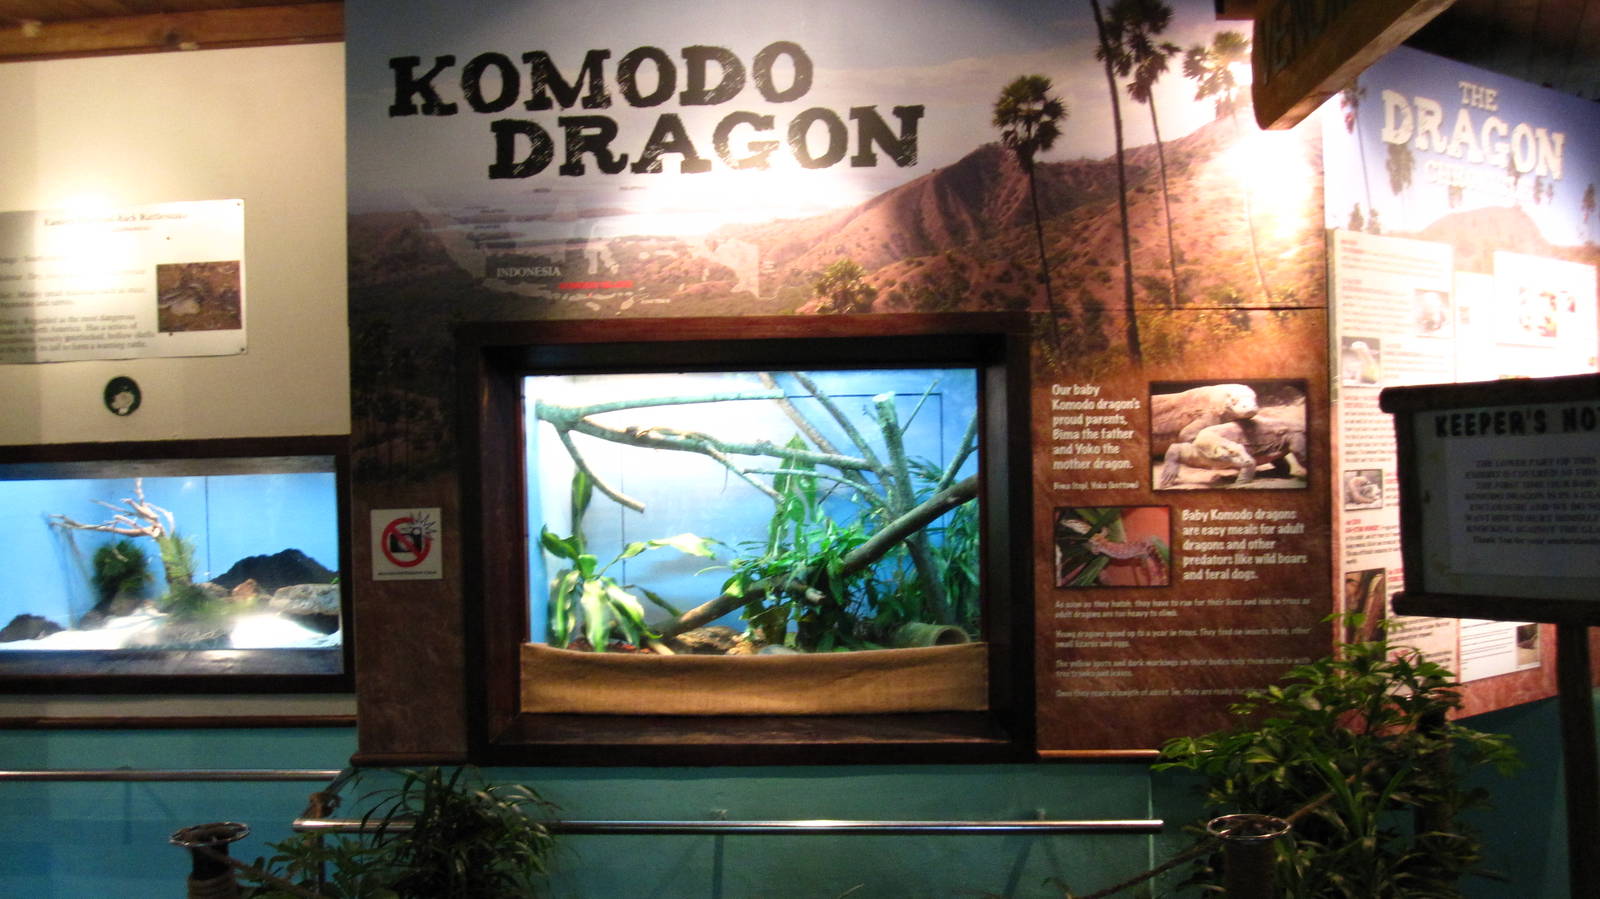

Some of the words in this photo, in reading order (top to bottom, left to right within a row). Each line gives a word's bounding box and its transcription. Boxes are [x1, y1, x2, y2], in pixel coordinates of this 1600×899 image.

[389, 40, 814, 118] KOMODO
[1459, 80, 1499, 112] THE
[1381, 88, 1566, 181] DRAGON
[489, 104, 925, 181] DRAGON
[496, 265, 562, 278] INDONESIA
[1052, 384, 1072, 396] Our
[1074, 384, 1100, 398] baby
[1052, 398, 1094, 411] Komodo
[1096, 398, 1141, 411] dragon's
[1053, 413, 1084, 427] proud
[1085, 413, 1128, 427] parents,
[1435, 408, 1548, 438] KEEPER'S
[1562, 404, 1600, 433] NO
[1052, 428, 1080, 440] Bima
[1081, 428, 1099, 440] the
[1100, 428, 1135, 440] father
[1053, 443, 1073, 455] and
[1075, 443, 1100, 455] Yoko
[1102, 443, 1120, 455] the
[1053, 457, 1092, 470] mother
[1093, 457, 1134, 472] dragon.
[1182, 509, 1207, 522] Baby
[1210, 508, 1253, 520] Komodo
[1254, 508, 1297, 521] dragons
[1182, 526, 1200, 535] are
[1202, 525, 1226, 537] easy
[1227, 524, 1258, 535] meals
[1260, 524, 1276, 535] for
[1278, 523, 1305, 534] adult
[1182, 539, 1224, 552] dragons
[1226, 538, 1247, 550] and
[1248, 538, 1276, 550] other
[1183, 553, 1233, 568] predators
[1234, 553, 1253, 565] like
[1255, 553, 1276, 565] wild
[1278, 552, 1308, 564] boars
[1183, 569, 1203, 580] and
[1205, 568, 1230, 580] feral
[1231, 567, 1259, 581] dogs.
